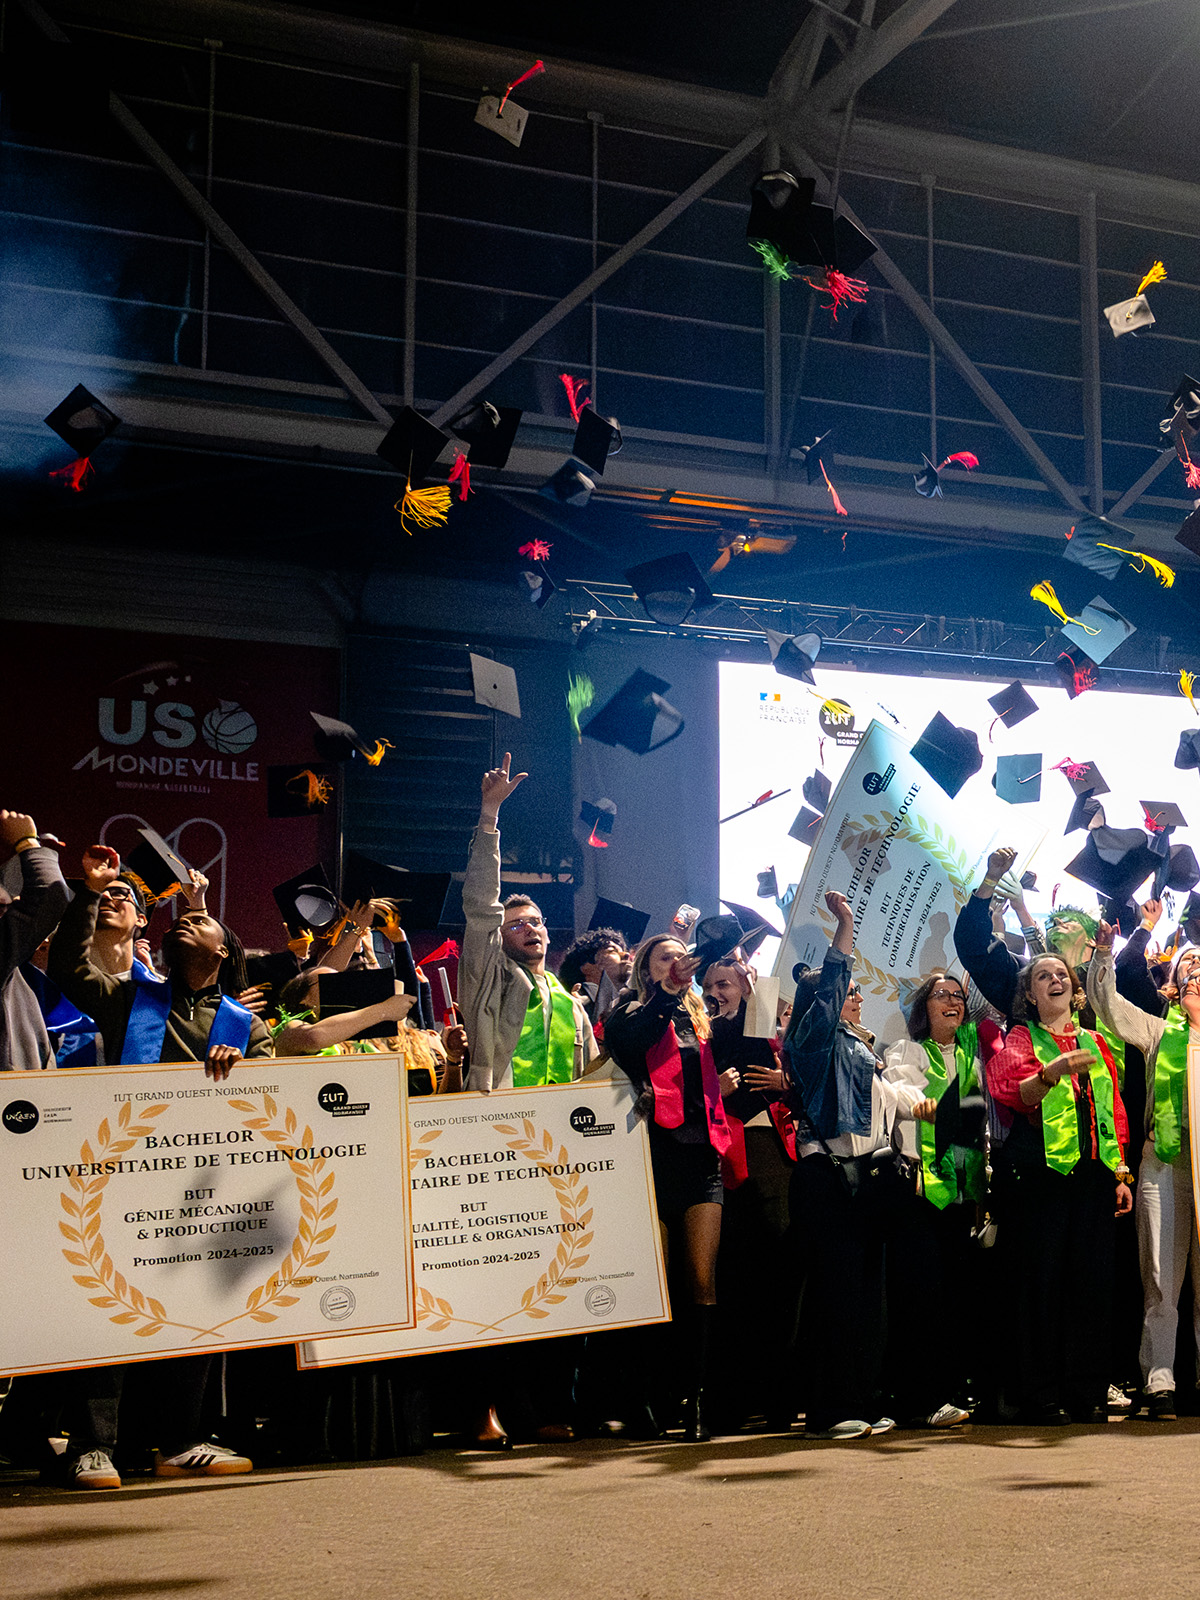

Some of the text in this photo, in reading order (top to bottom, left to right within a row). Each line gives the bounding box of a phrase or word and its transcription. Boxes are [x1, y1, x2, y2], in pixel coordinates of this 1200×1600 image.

[72, 746, 259, 782] MONDEVILLE
[863, 876, 876, 896] DE
[871, 782, 921, 875] TECHNOLOGIE
[846, 846, 872, 905] ACHELOR
[880, 892, 892, 915] BUT
[881, 867, 915, 949] TECHNIQUES DE
[888, 860, 932, 968] COMMERCIALISATION
[905, 881, 942, 968] Promotion 2024-2025
[135, 1090, 174, 1101] GRAND
[176, 1088, 213, 1099] OUEST
[215, 1084, 280, 1097] NORMANDIE
[322, 1093, 344, 1103] IUT
[414, 1110, 537, 1128] GRAND OUEST NORMANDIE
[574, 1115, 592, 1125] IUT
[144, 1129, 255, 1150] BACHELOR
[22, 1144, 367, 1181] UNIVERSITAIRE DE TECHNOLOGIE
[424, 1150, 517, 1169] BACHELOR
[467, 1172, 490, 1185] DE
[494, 1160, 615, 1182] TECHNOLOGIE
[183, 1188, 216, 1201] BUT
[123, 1200, 275, 1224] GÉNIE MÉCANIQUE
[460, 1201, 488, 1214] BUT
[136, 1218, 269, 1240] & PRODUCTIQUE
[412, 1211, 549, 1234] UALITÉ, LOGISTIQUE
[413, 1221, 587, 1249] TRIELLE & ORGANISATION
[133, 1245, 274, 1268] Promotion 2024-2025
[421, 1250, 540, 1271] Promotion 2024-2025
